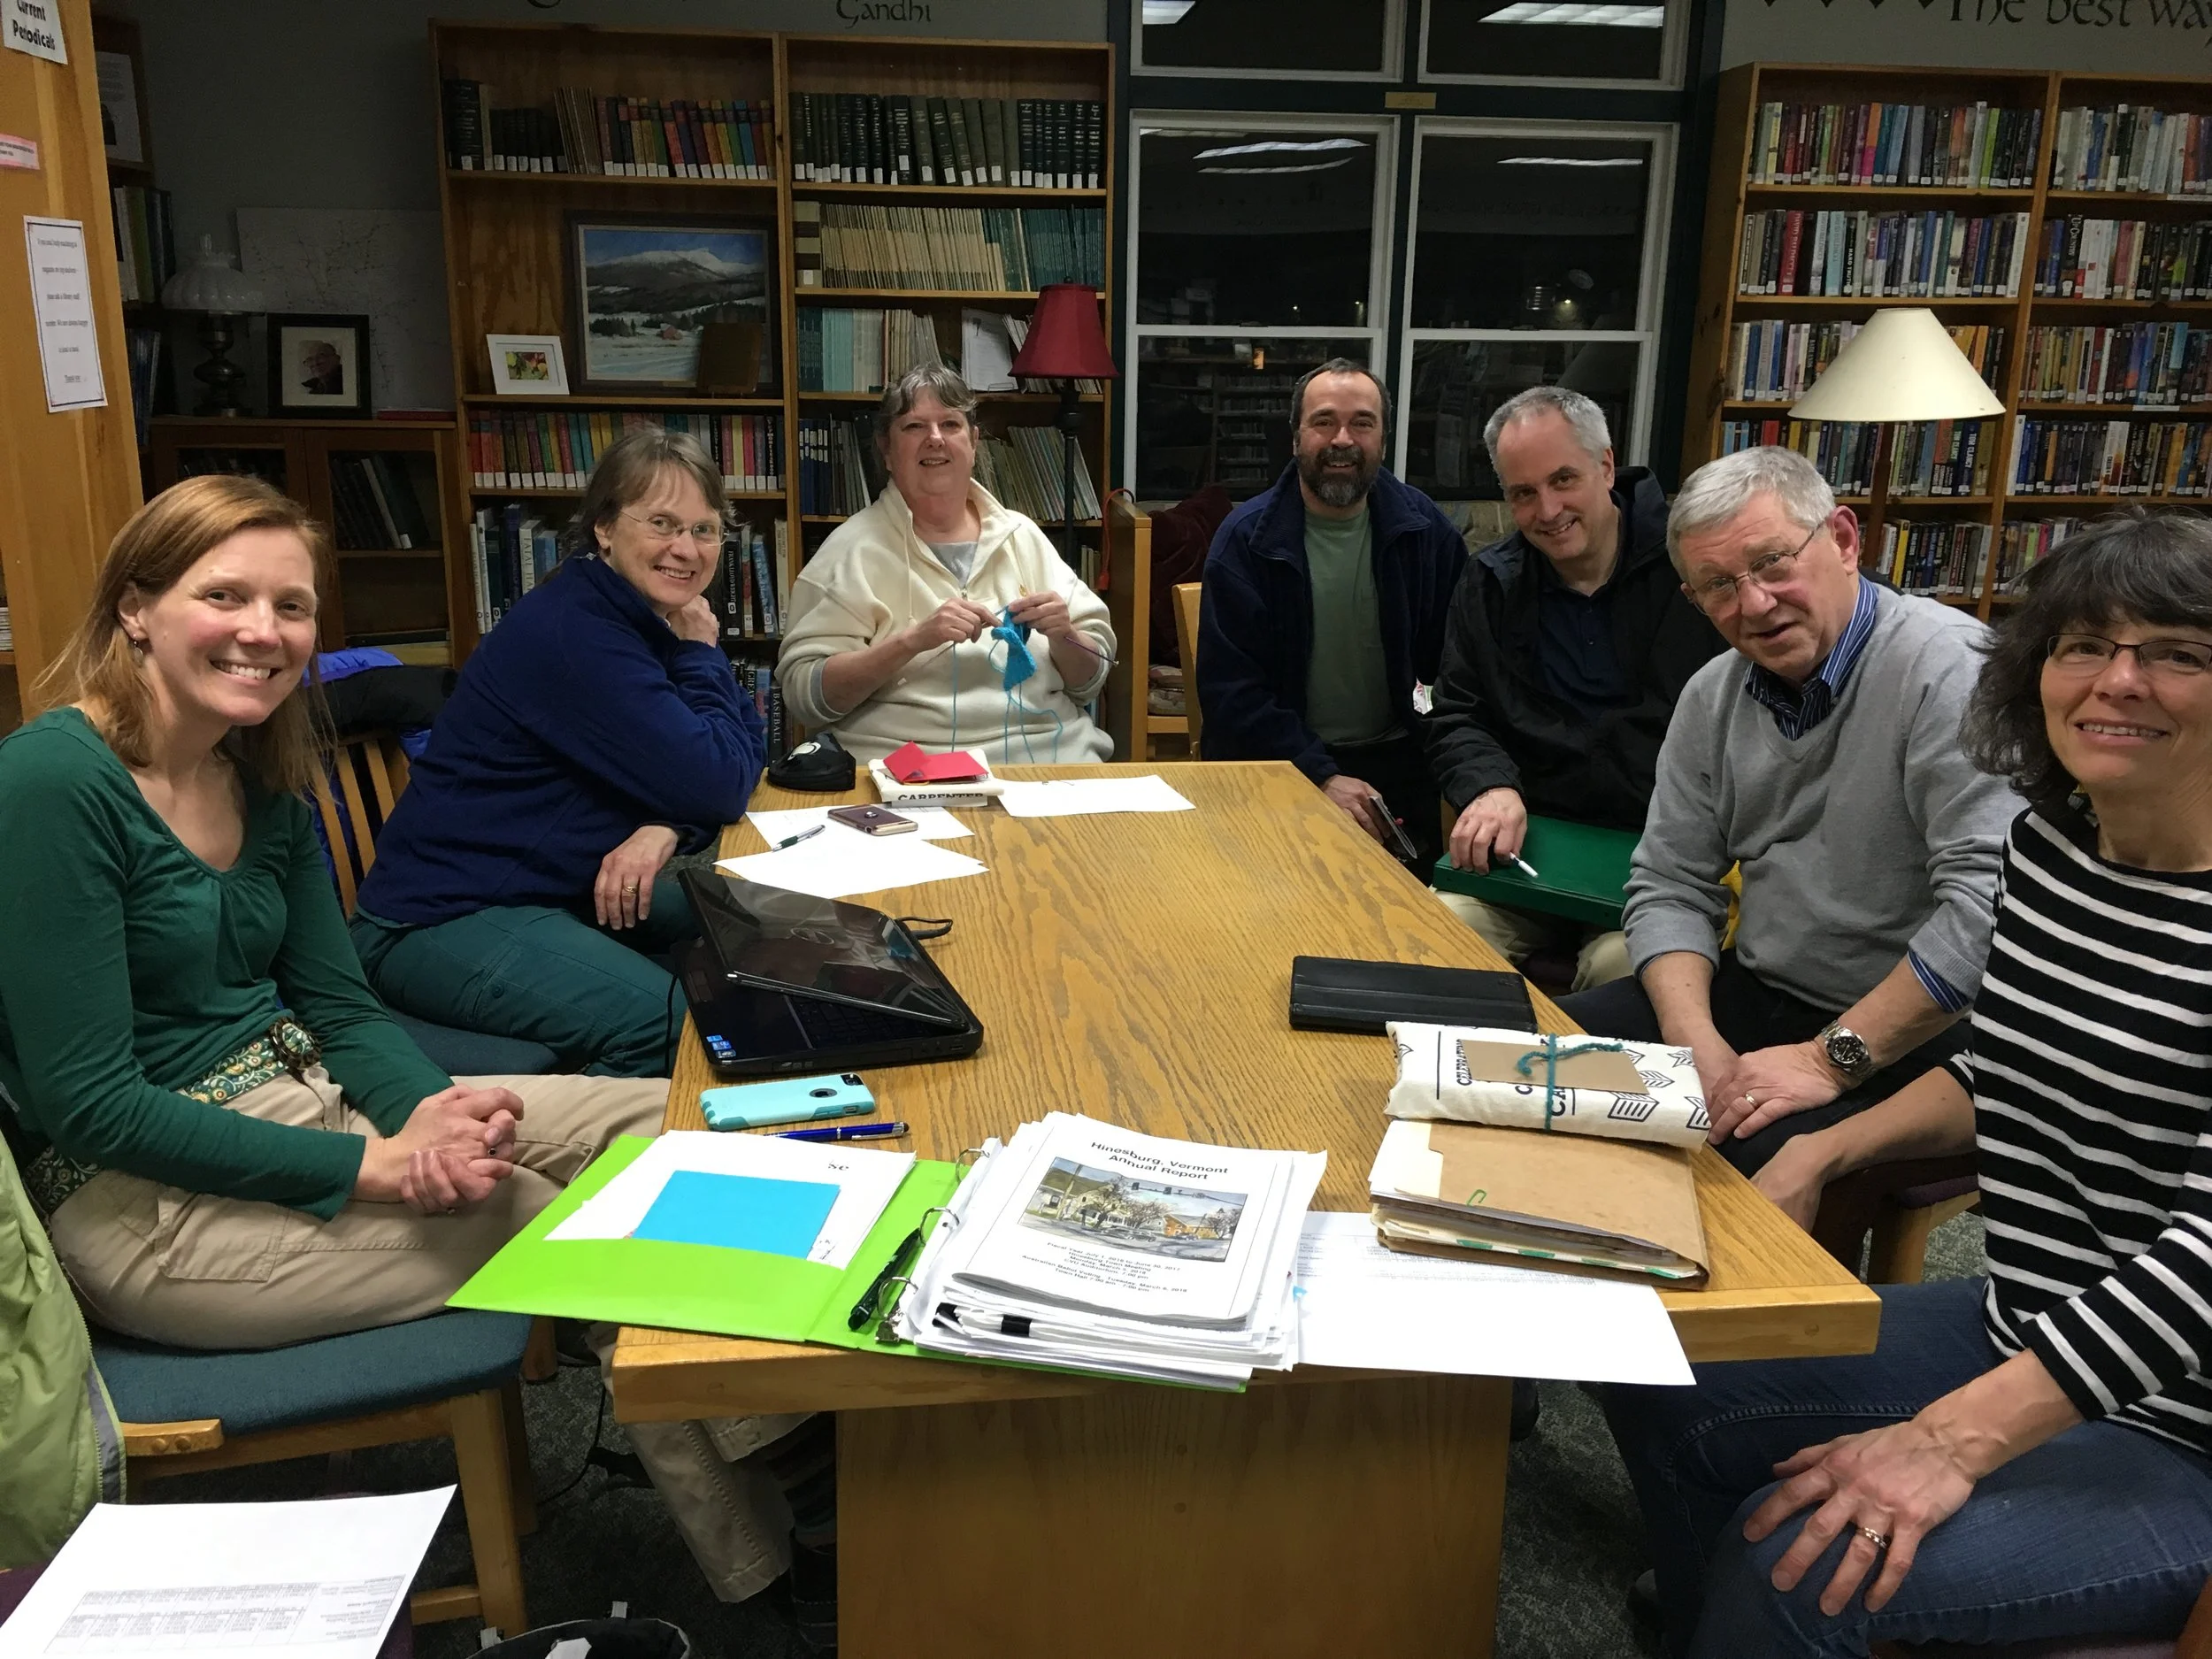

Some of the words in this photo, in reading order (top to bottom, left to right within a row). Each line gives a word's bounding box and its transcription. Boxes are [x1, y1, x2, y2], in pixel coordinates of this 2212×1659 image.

[17, 0, 45, 21] Current
[836, 0, 932, 29] Gandhi
[2047, 0, 2131, 27] best
[12, 19, 55, 50] Periodicals
[1968, 433, 1977, 445] TOM
[1964, 447, 1975, 468] CLANCY
[1091, 1141, 1164, 1165] Hinesburg,
[1170, 1161, 1228, 1174] Vermont
[1109, 1155, 1157, 1171] Annual
[1161, 1167, 1209, 1179] Report
